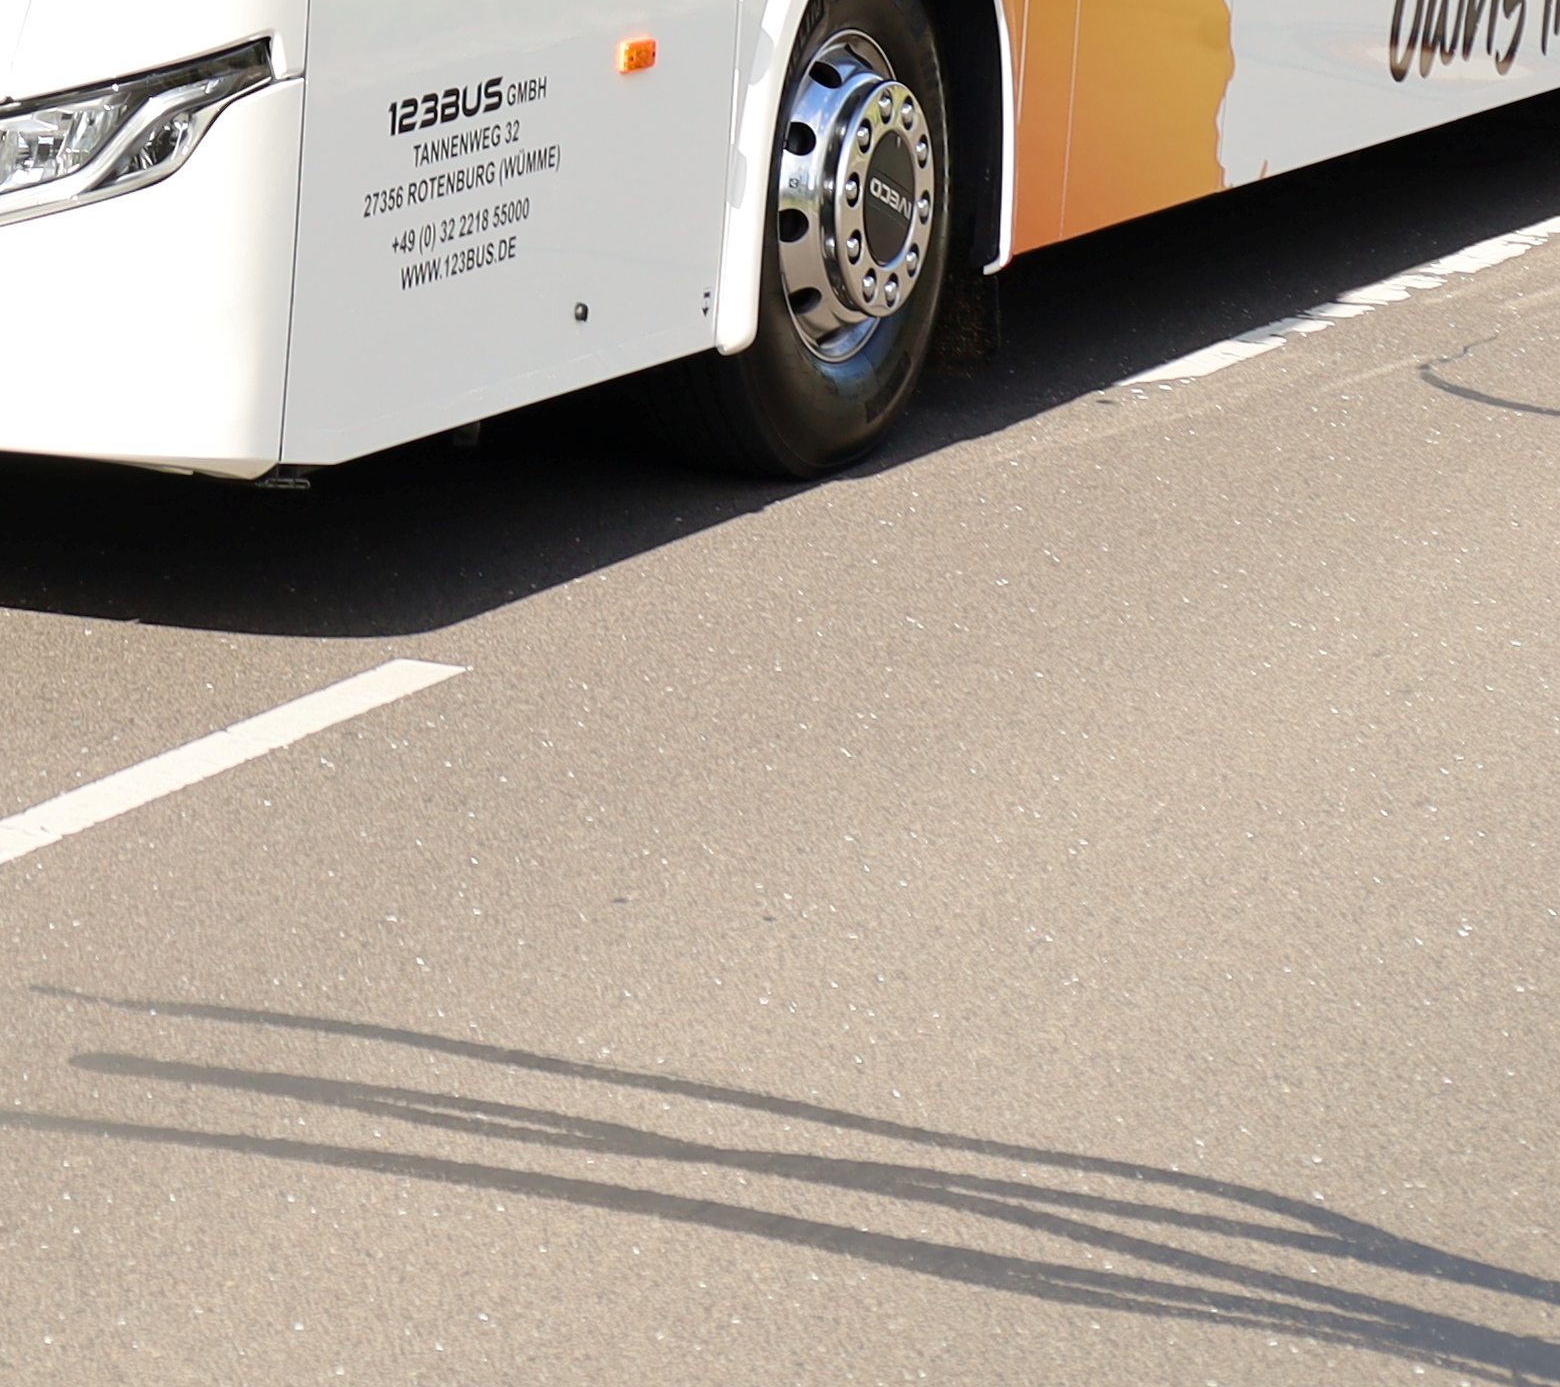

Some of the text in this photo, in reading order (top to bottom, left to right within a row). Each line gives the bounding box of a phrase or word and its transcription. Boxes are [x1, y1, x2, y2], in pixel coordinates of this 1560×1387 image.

[388, 76, 547, 137] 123BUS GMBH
[413, 119, 520, 168] TANNENWEG 32
[363, 144, 562, 218] 27356 ROTENBURG (WÜMME)
[870, 177, 912, 220] IVECO
[391, 197, 531, 255] +49 (0) 32 2218 55000
[401, 235, 518, 291] WWW.123BUS.DE
